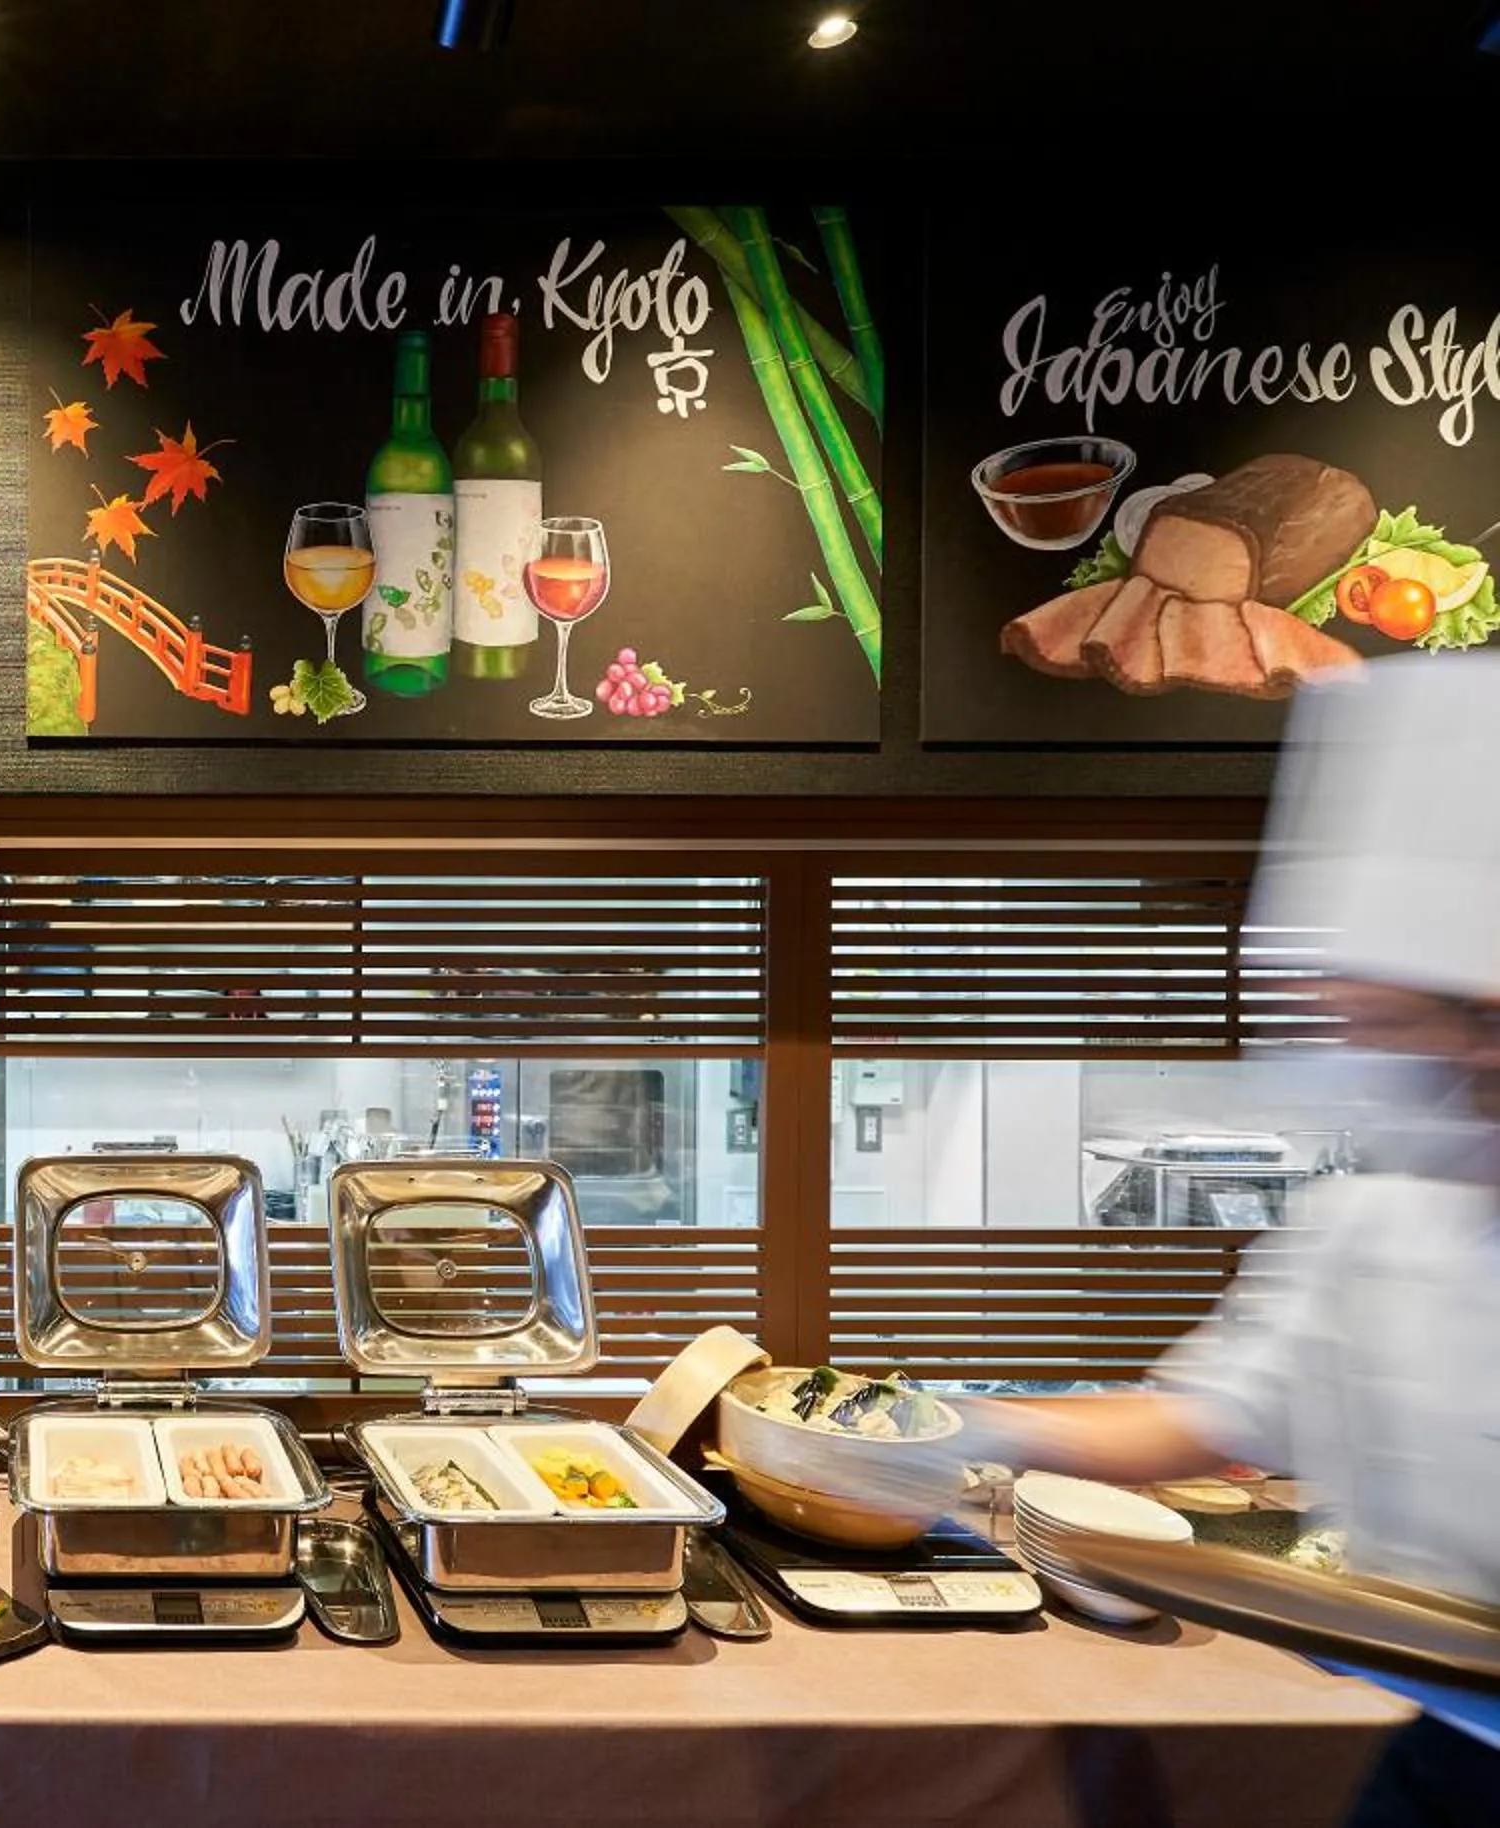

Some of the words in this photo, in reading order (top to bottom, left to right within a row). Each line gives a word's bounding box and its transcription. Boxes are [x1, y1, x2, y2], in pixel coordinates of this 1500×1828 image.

[180, 234, 408, 332] Made
[433, 263, 521, 327] in
[536, 236, 714, 384] Kyoto
[1088, 263, 1226, 350] Enjoy
[646, 334, 714, 419] 京
[1000, 294, 1357, 433] Japanese
